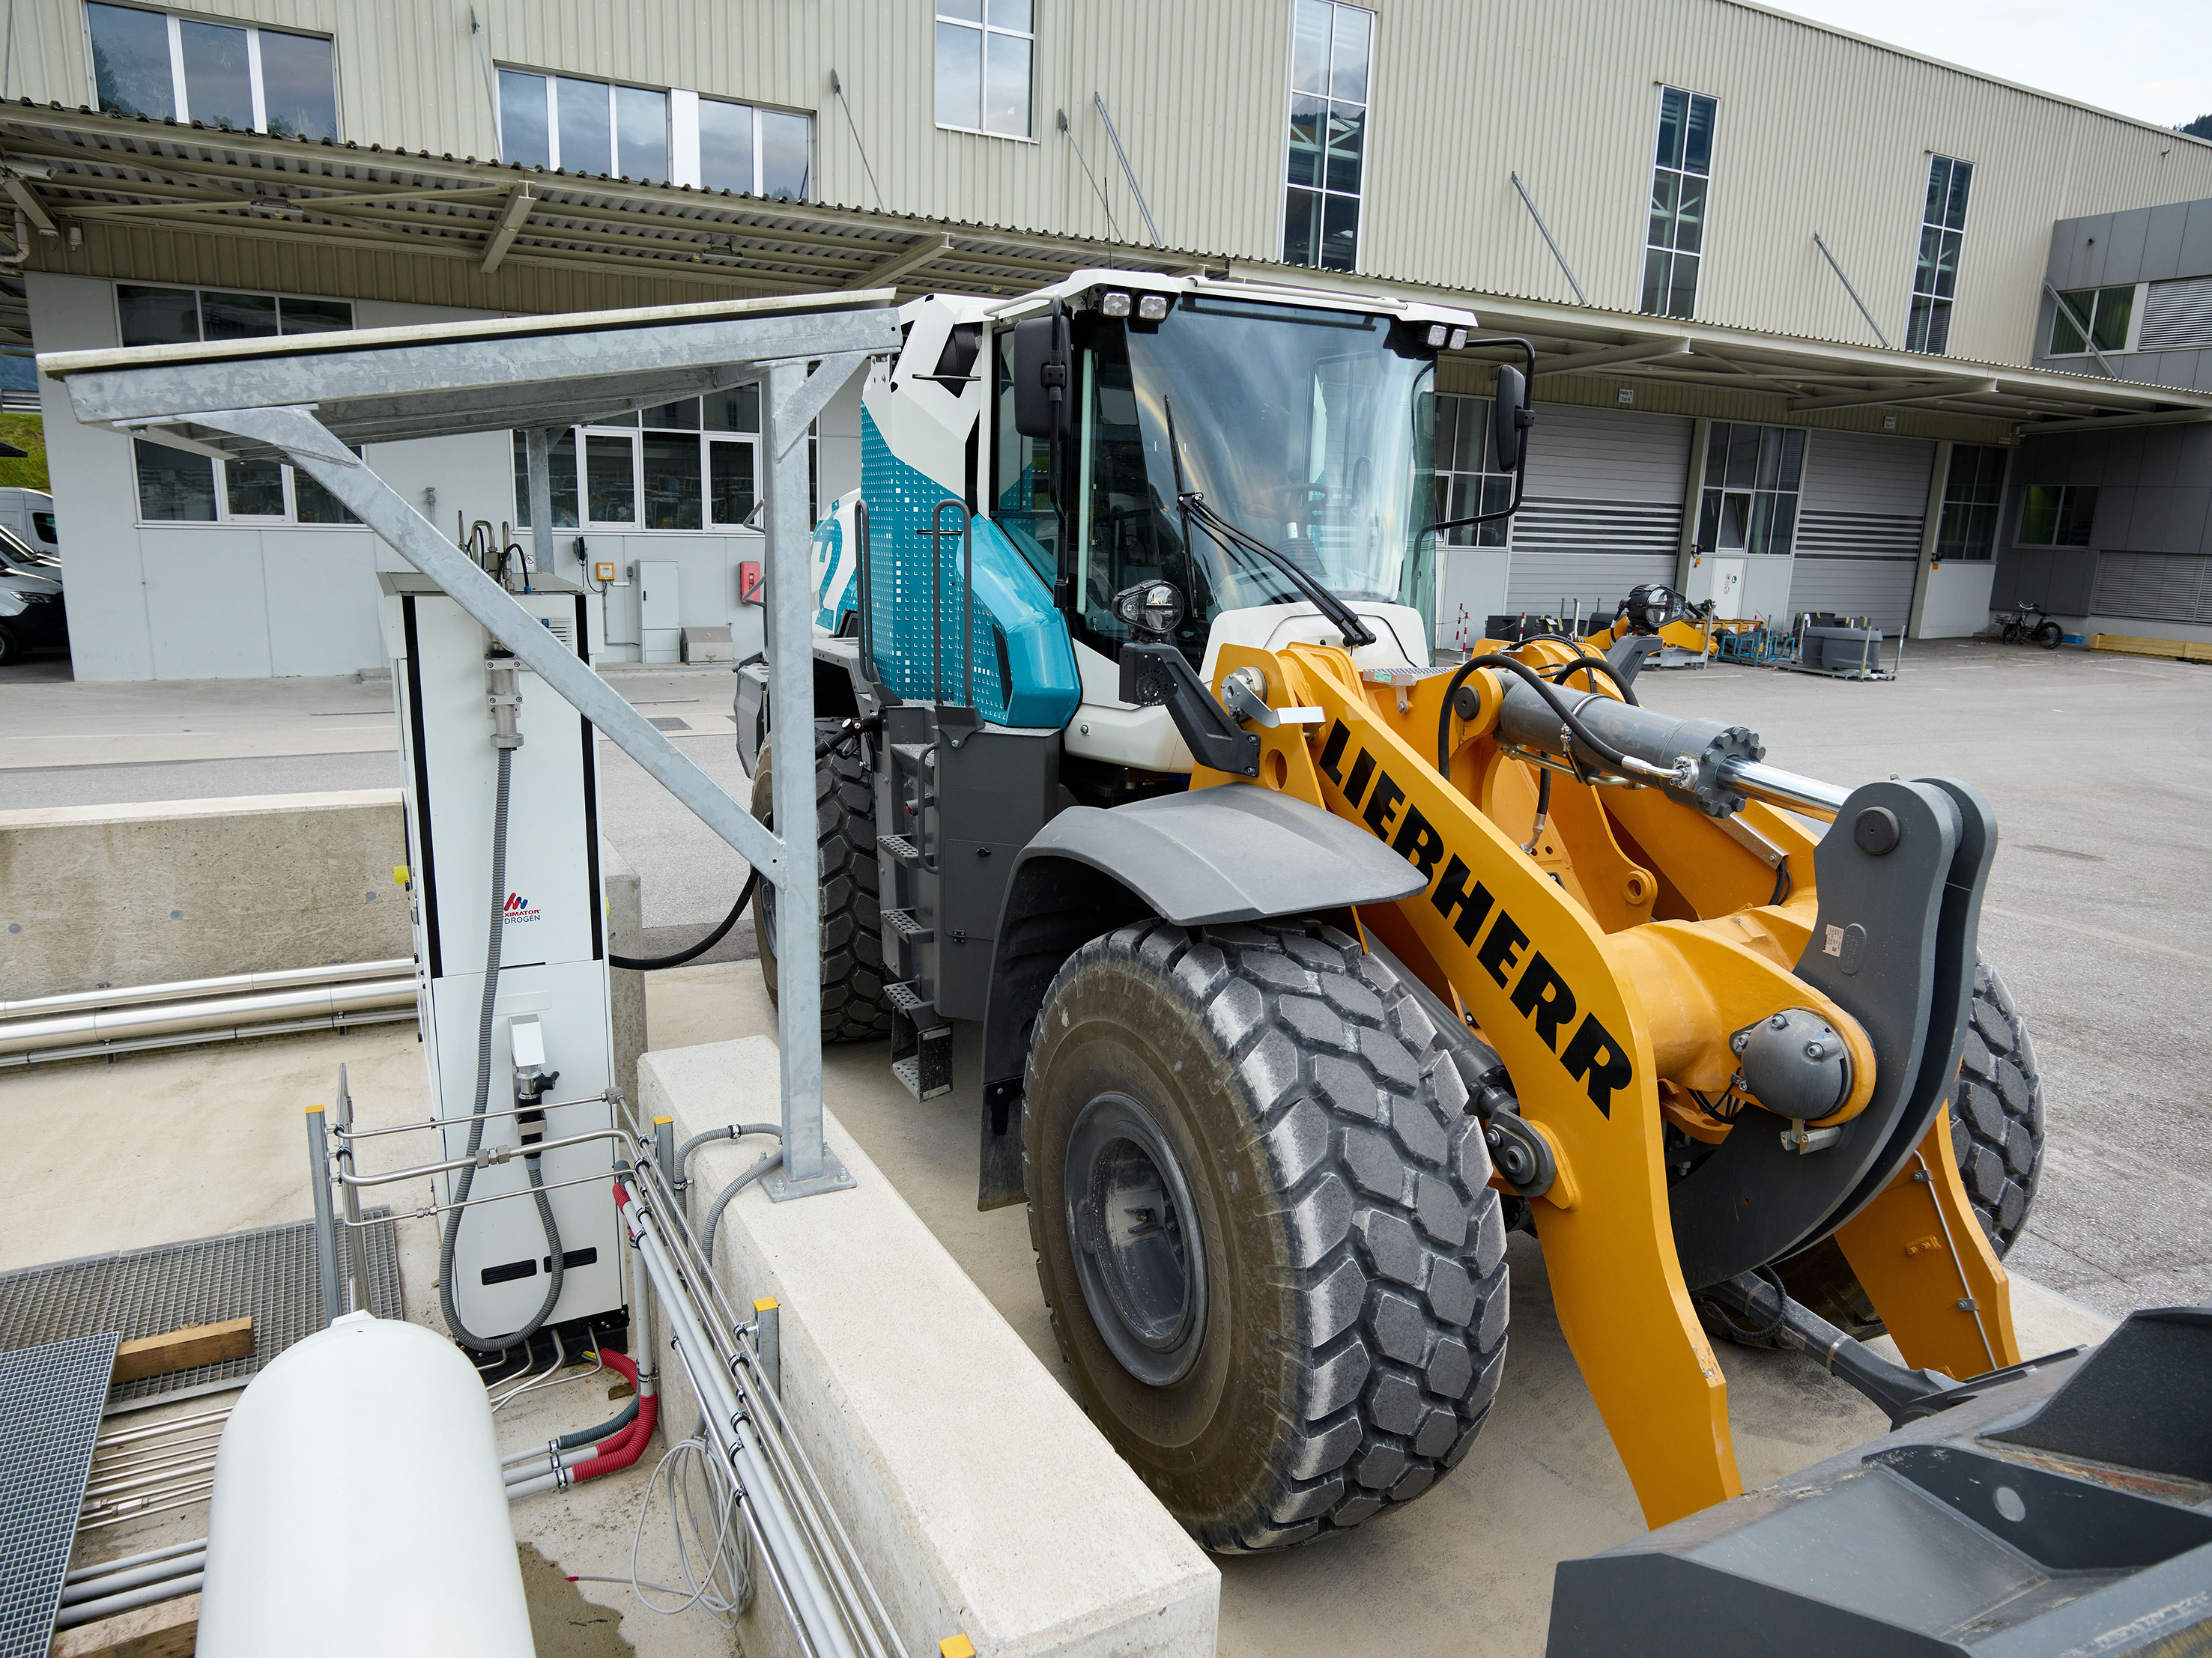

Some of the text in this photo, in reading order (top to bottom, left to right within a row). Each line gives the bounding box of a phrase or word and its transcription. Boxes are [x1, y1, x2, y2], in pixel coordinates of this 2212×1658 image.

[503, 909, 540, 917] XIMATOR
[503, 914, 540, 925] DROGEN
[1318, 717, 1632, 1121] LIEBHERR
